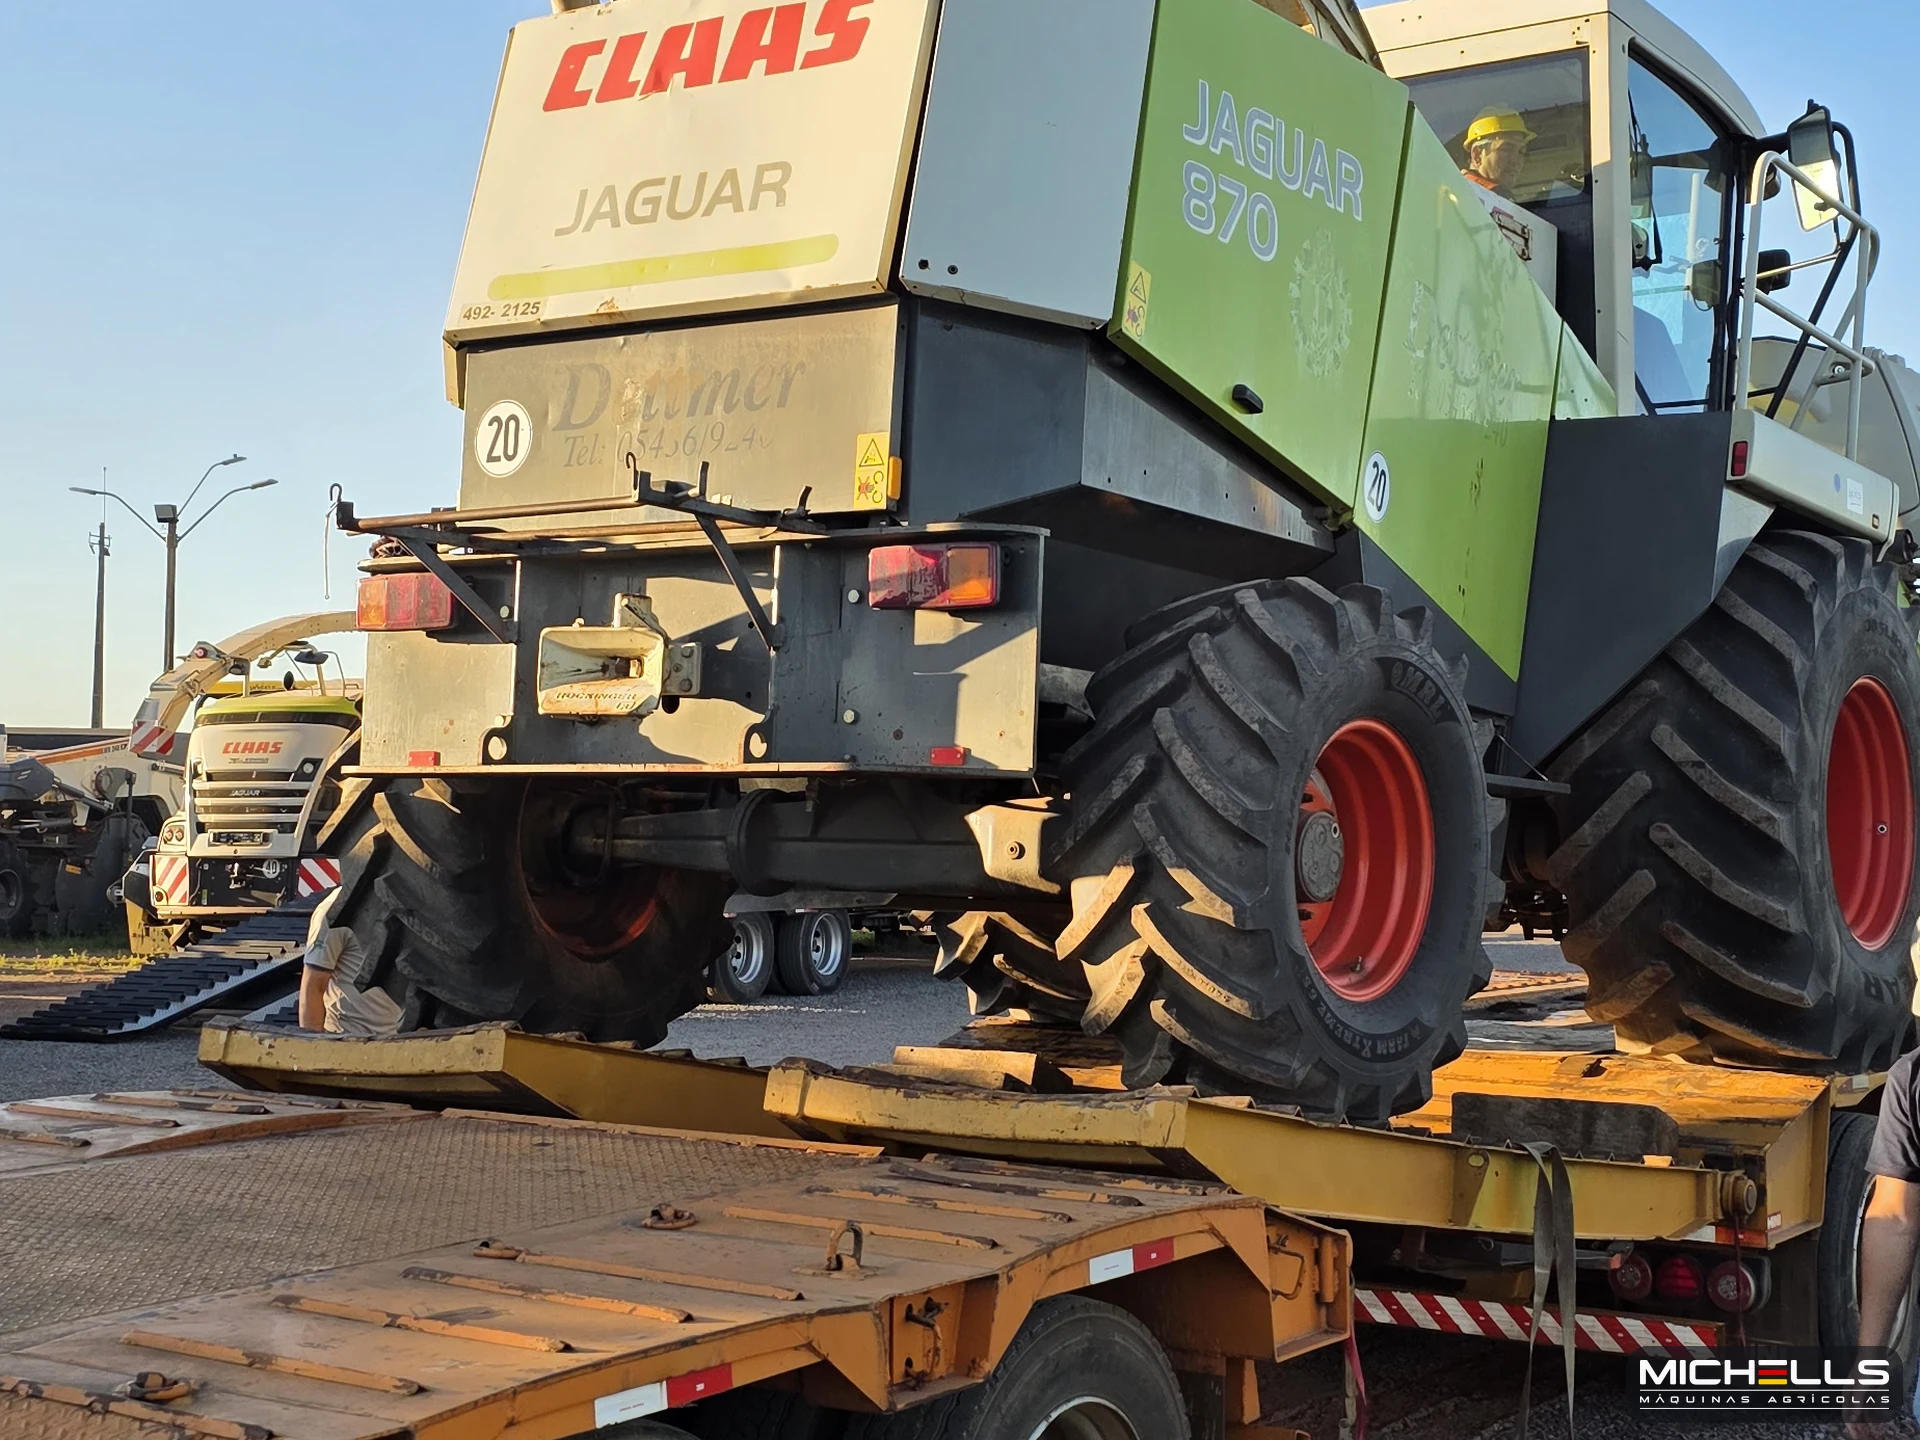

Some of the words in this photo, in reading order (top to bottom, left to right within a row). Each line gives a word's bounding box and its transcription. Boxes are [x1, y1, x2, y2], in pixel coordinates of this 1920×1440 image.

[542, 0, 875, 112] CLAAS
[1183, 79, 1364, 222] JAGUAR
[554, 161, 792, 237] JAGUAR
[1182, 160, 1278, 262] 870
[501, 300, 541, 317] 2125
[486, 413, 521, 464] 20
[1367, 461, 1387, 512] 20
[222, 741, 284, 754] CLAAS
[230, 789, 261, 797] JAGUAR
